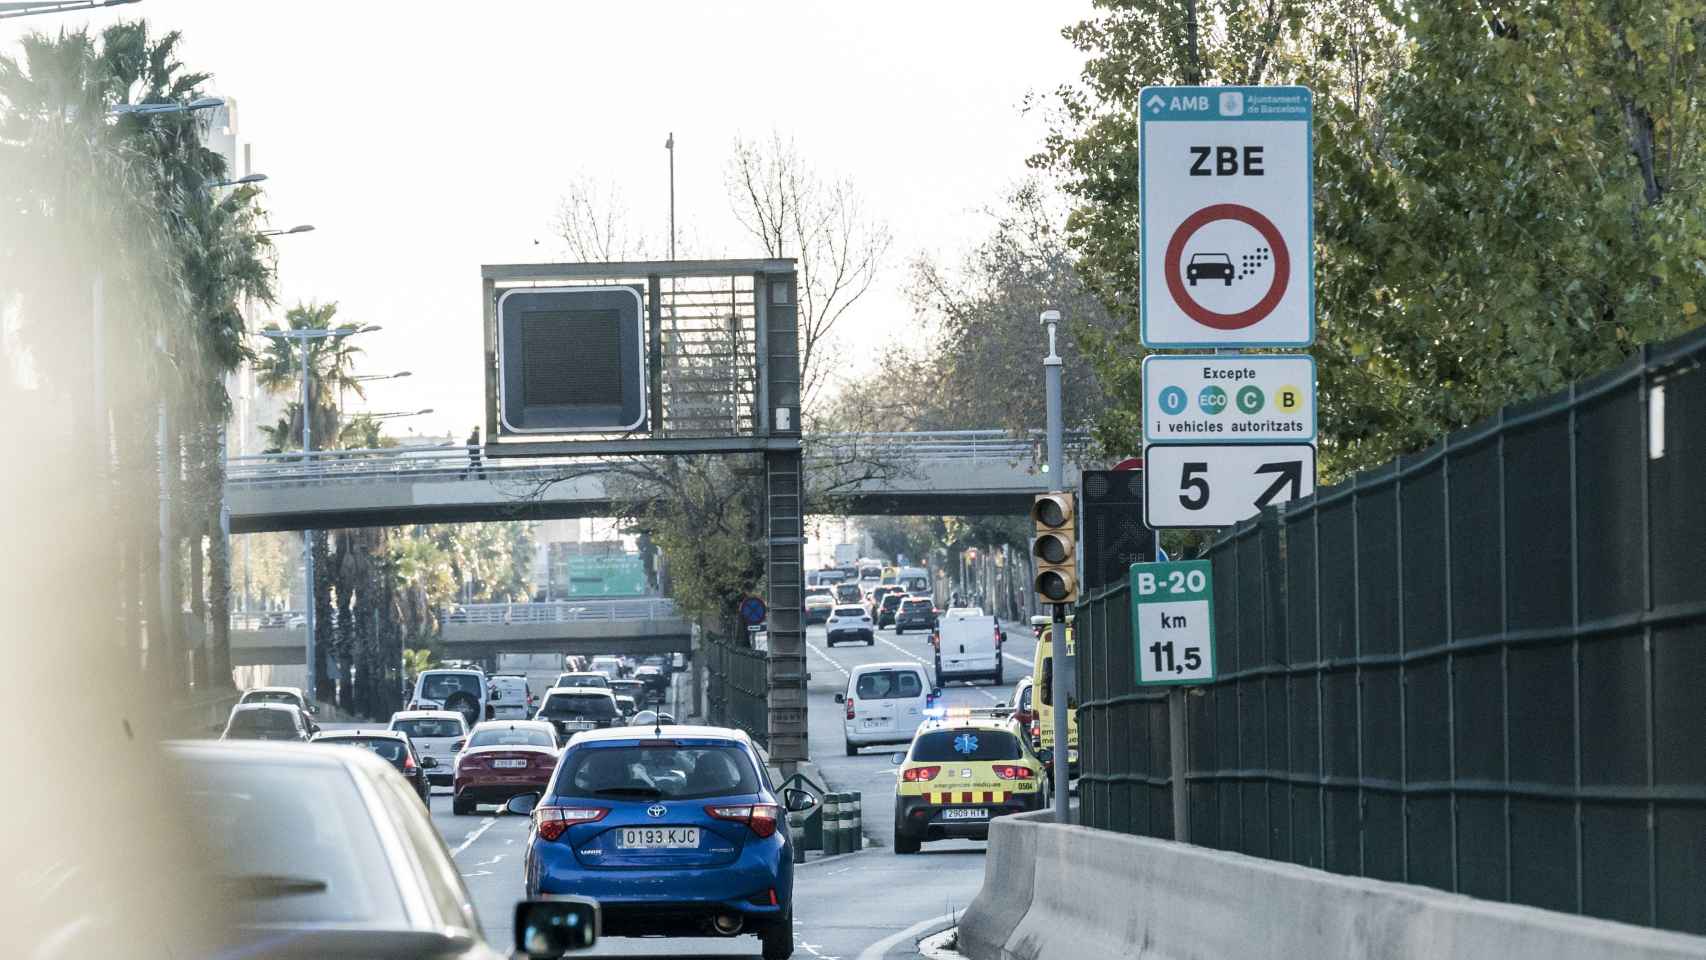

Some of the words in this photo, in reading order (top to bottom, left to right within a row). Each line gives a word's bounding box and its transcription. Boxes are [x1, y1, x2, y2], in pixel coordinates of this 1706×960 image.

[1169, 96, 1209, 111] AMB
[1247, 95, 1300, 105] Ajuntament
[1247, 105, 1257, 113] de
[1261, 105, 1306, 113] Barcelona
[1189, 146, 1264, 176] ZBE
[1203, 367, 1256, 381] Excepte
[1167, 393, 1178, 408] 0
[1200, 394, 1226, 406] ECO
[1244, 392, 1257, 408] C
[1283, 392, 1295, 407] B
[1156, 421, 1161, 432] i
[1168, 421, 1223, 432] vehicles
[1231, 420, 1303, 432] autoritzats
[1179, 462, 1210, 510] 5
[1138, 570, 1206, 595] B-20
[1161, 612, 1187, 628] km
[1149, 641, 1202, 674] 11,5
[627, 830, 663, 844] 0193
[668, 830, 695, 843] KJC
